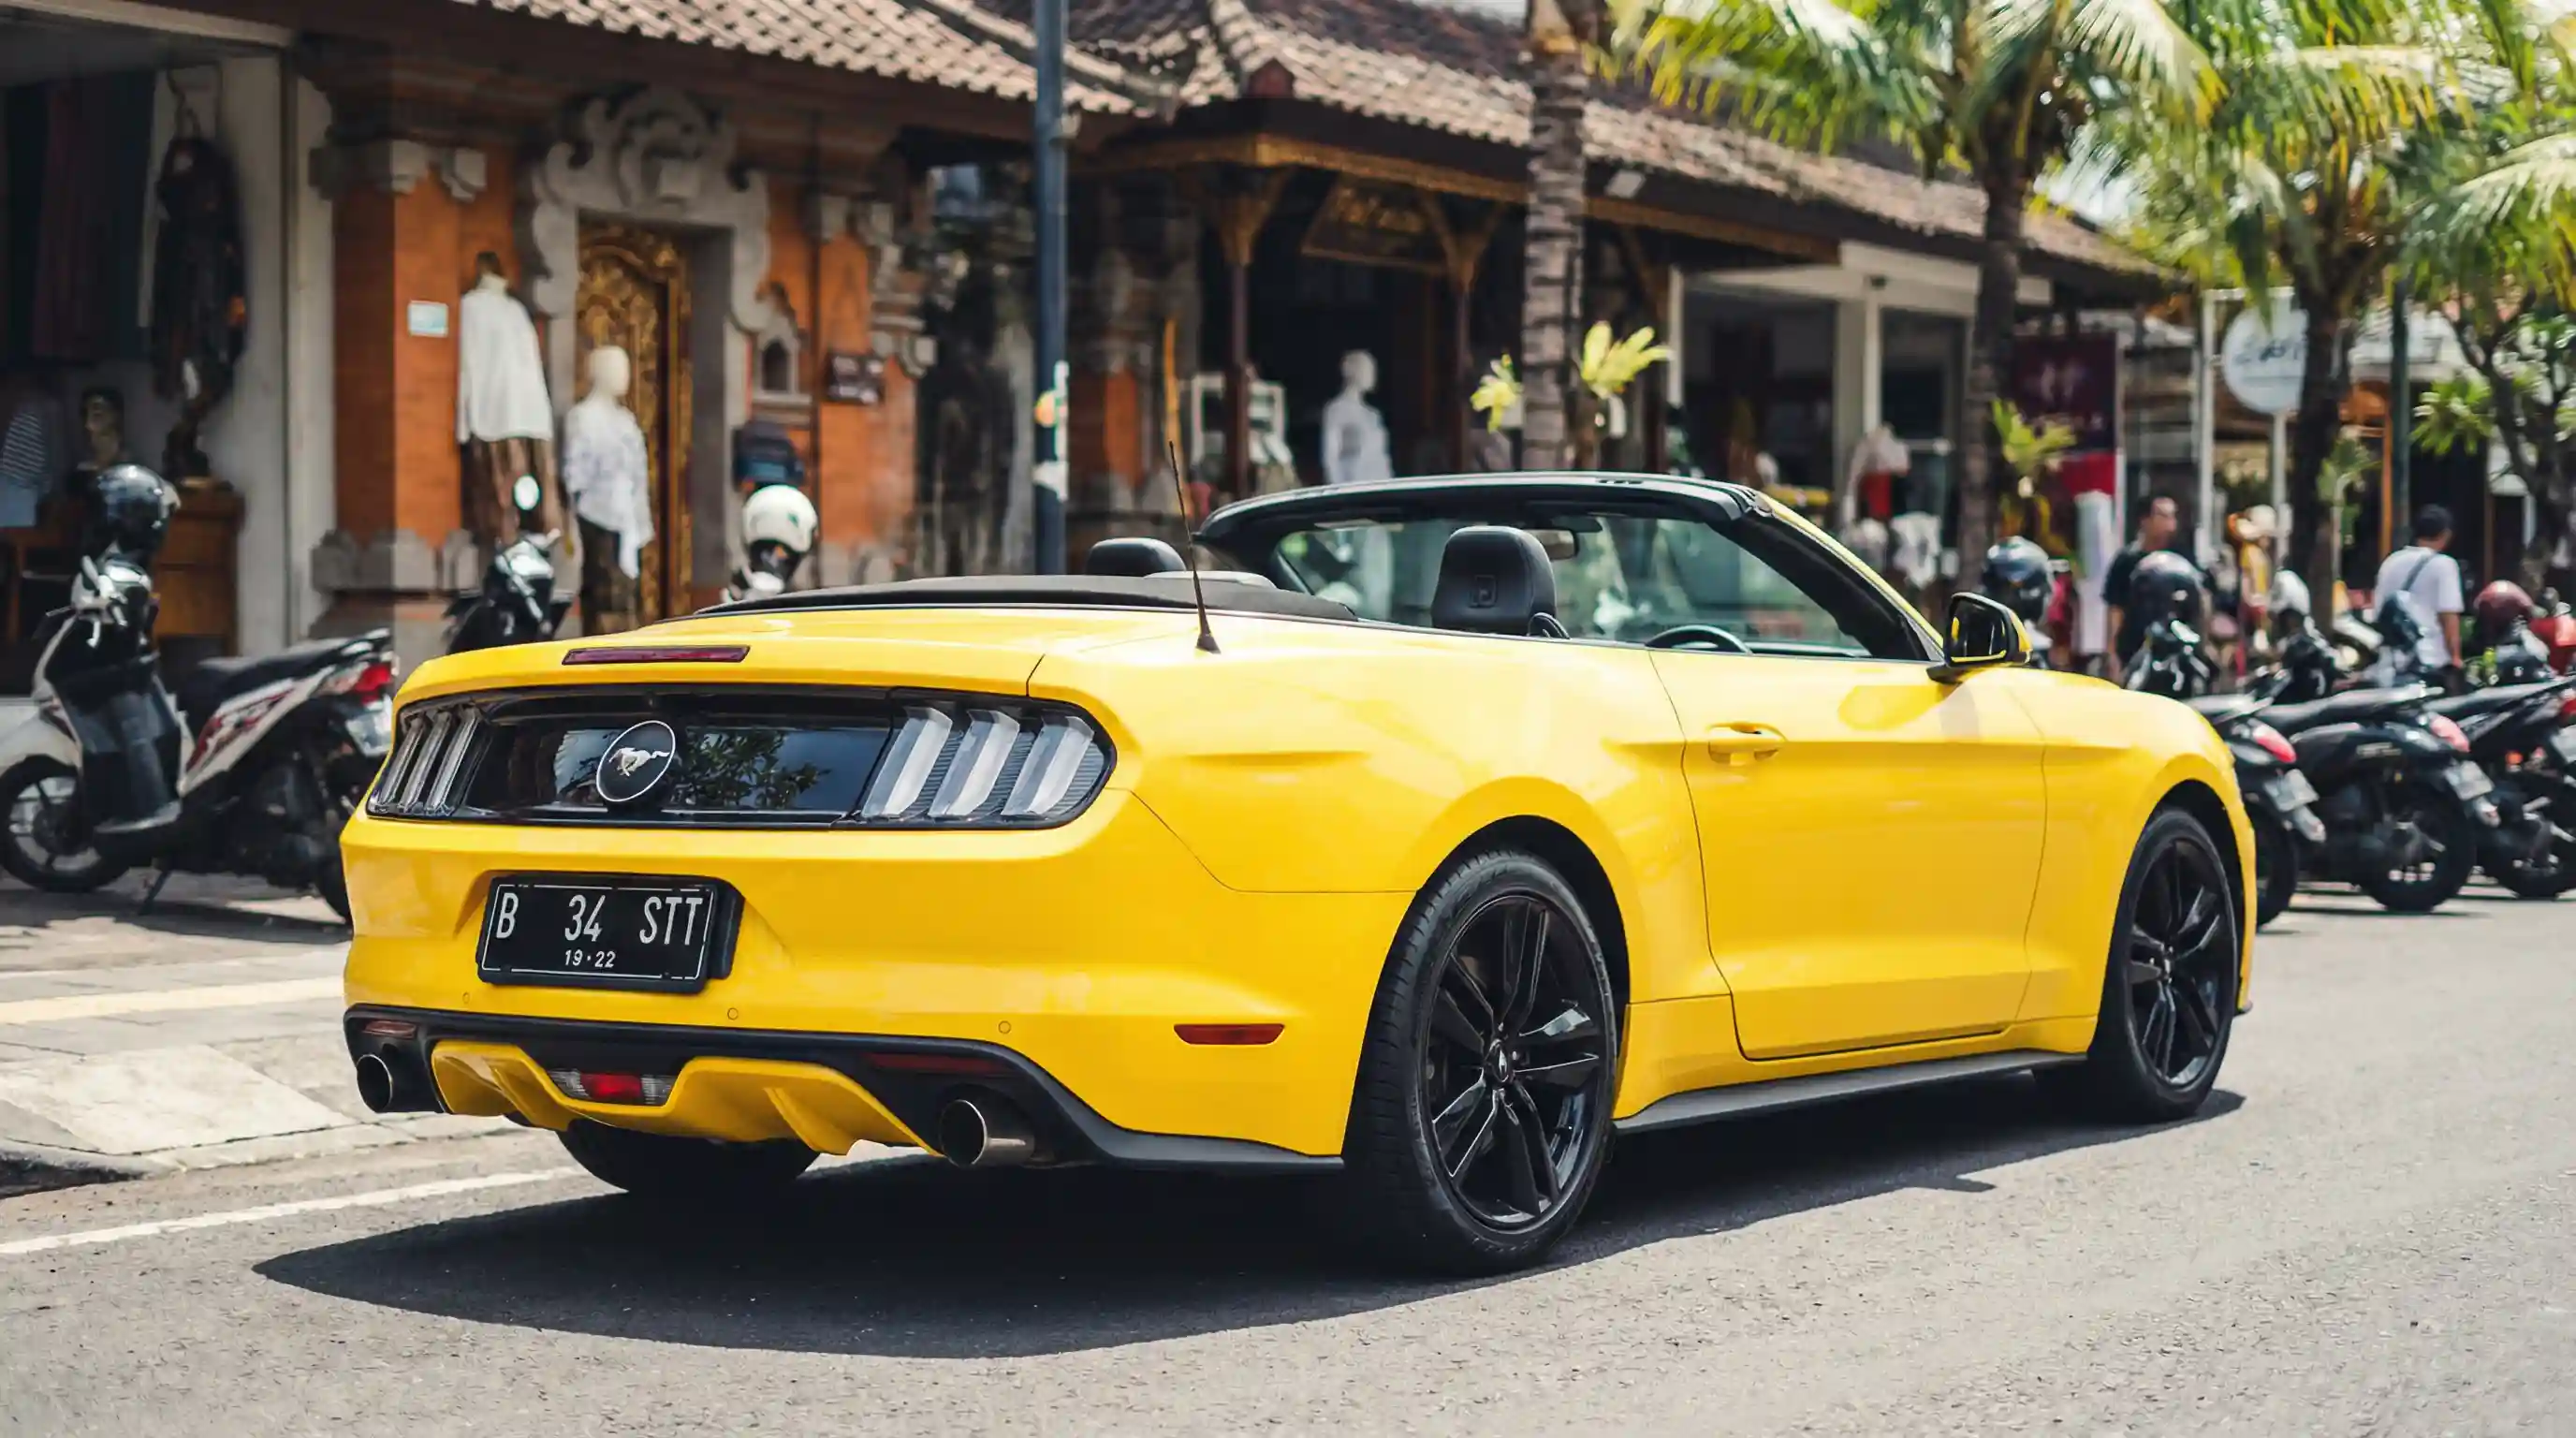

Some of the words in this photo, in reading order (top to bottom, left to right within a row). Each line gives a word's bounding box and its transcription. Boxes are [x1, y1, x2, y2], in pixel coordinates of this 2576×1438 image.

[495, 892, 520, 939] B
[564, 894, 606, 942] 34
[638, 896, 704, 946] STT
